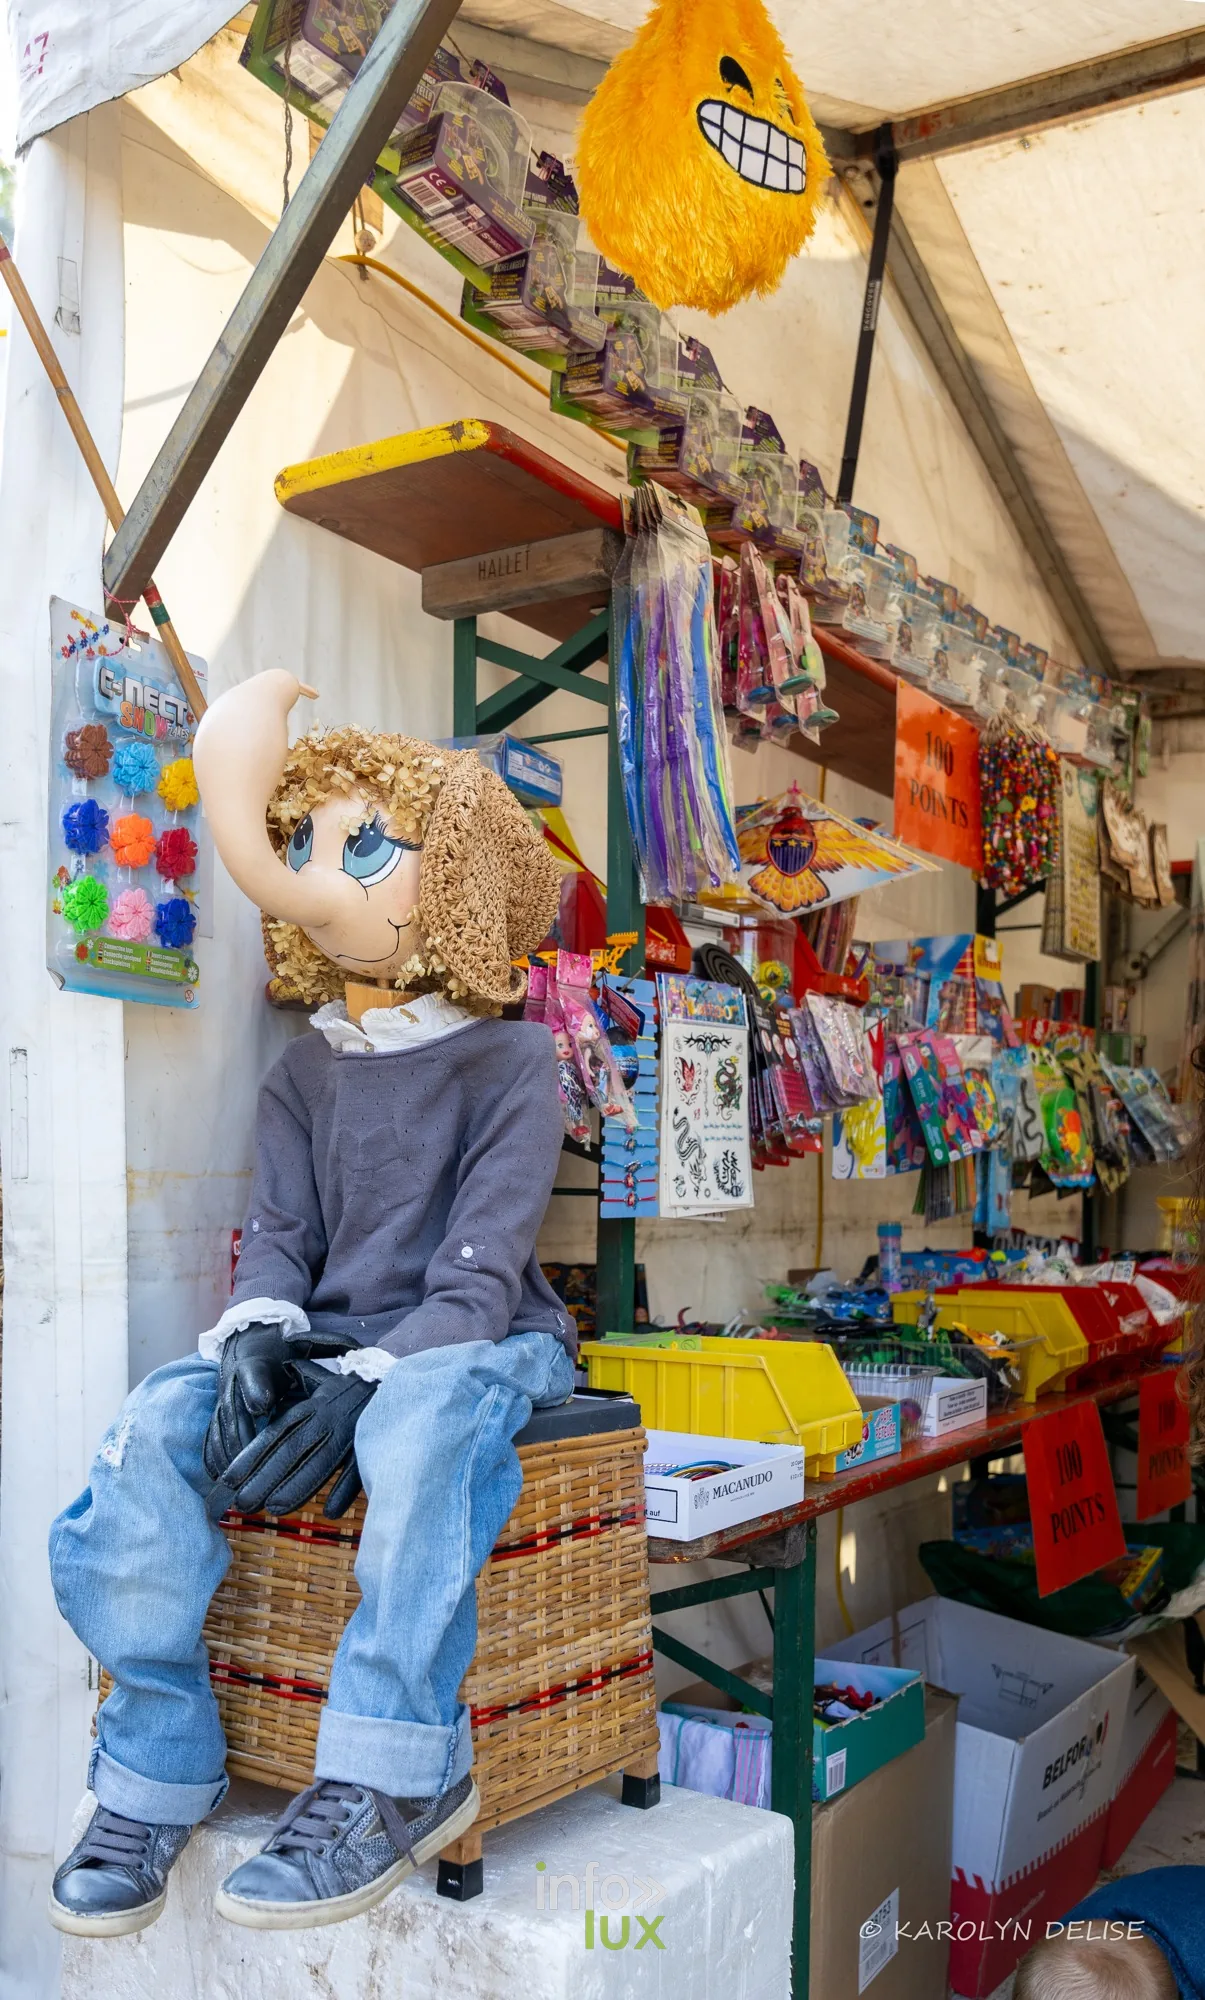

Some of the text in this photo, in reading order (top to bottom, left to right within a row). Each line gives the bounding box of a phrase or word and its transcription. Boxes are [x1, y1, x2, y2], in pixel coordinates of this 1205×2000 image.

[478, 550, 531, 581] HALLET
[925, 730, 954, 777] 100
[910, 777, 969, 829] POINTS
[1055, 1439, 1084, 1487] 100
[1147, 1446, 1186, 1481] POINTS
[712, 1470, 773, 1500] MACANUDO
[649, 1509, 661, 1518] auf
[1050, 1492, 1106, 1545] POINTS
